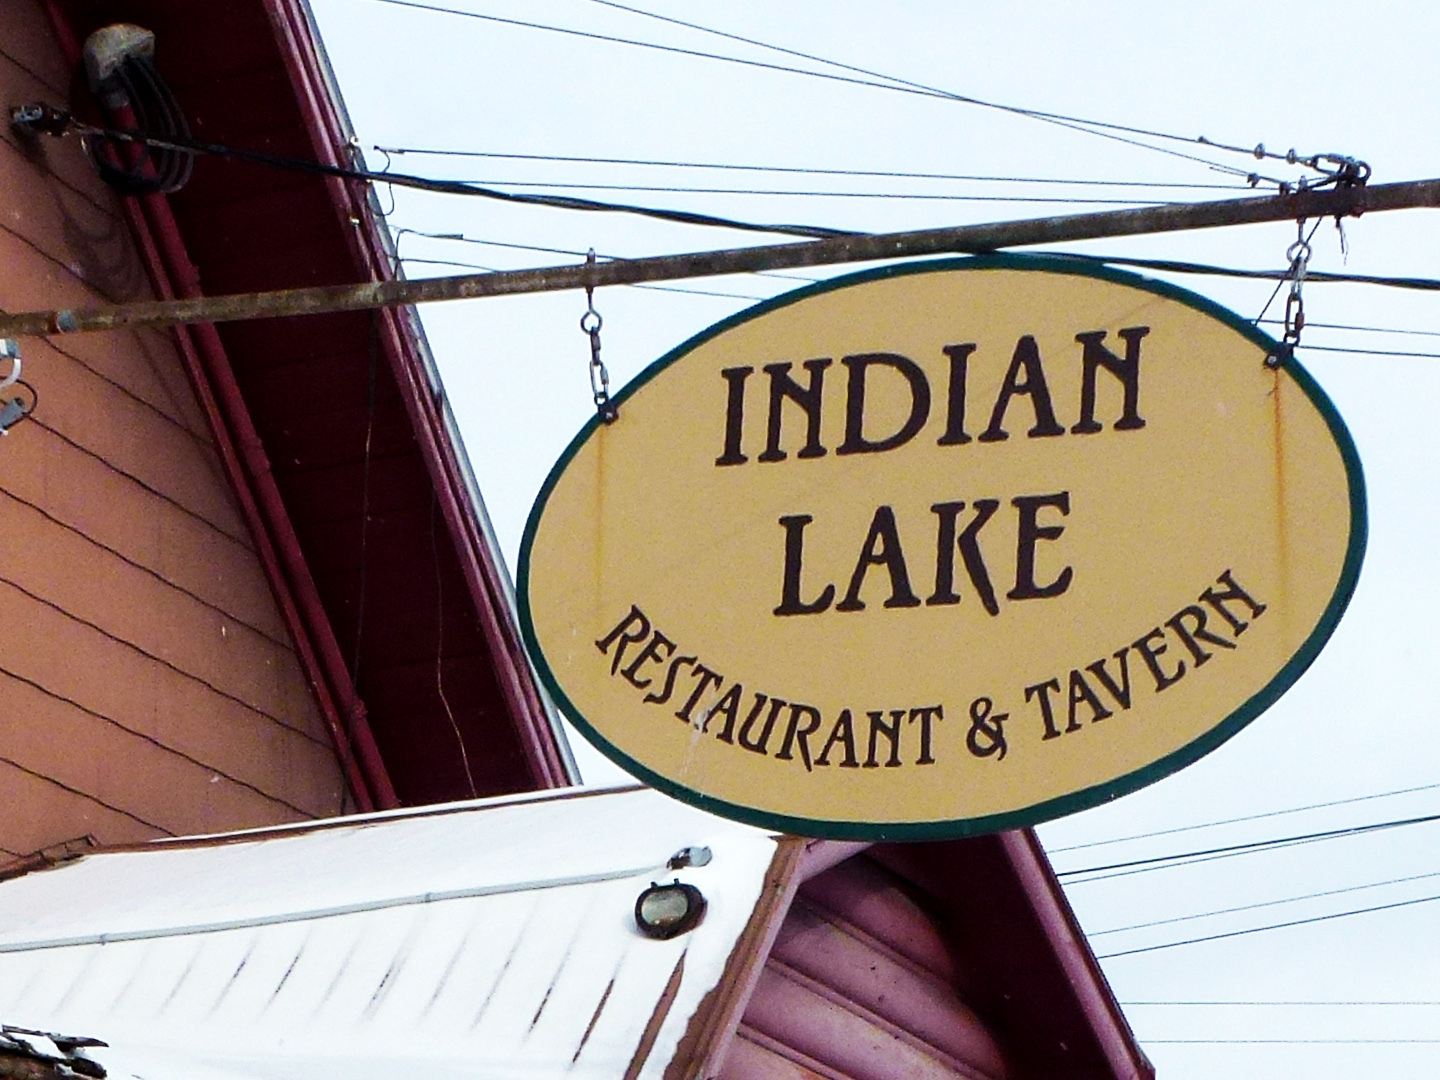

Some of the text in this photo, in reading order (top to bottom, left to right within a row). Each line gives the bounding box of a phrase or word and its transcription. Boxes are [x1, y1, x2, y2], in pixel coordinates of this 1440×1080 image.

[715, 326, 1150, 467] INDIAN
[773, 491, 1073, 617] LAKE
[594, 568, 1268, 773] RESTAURANT & TAVERN
